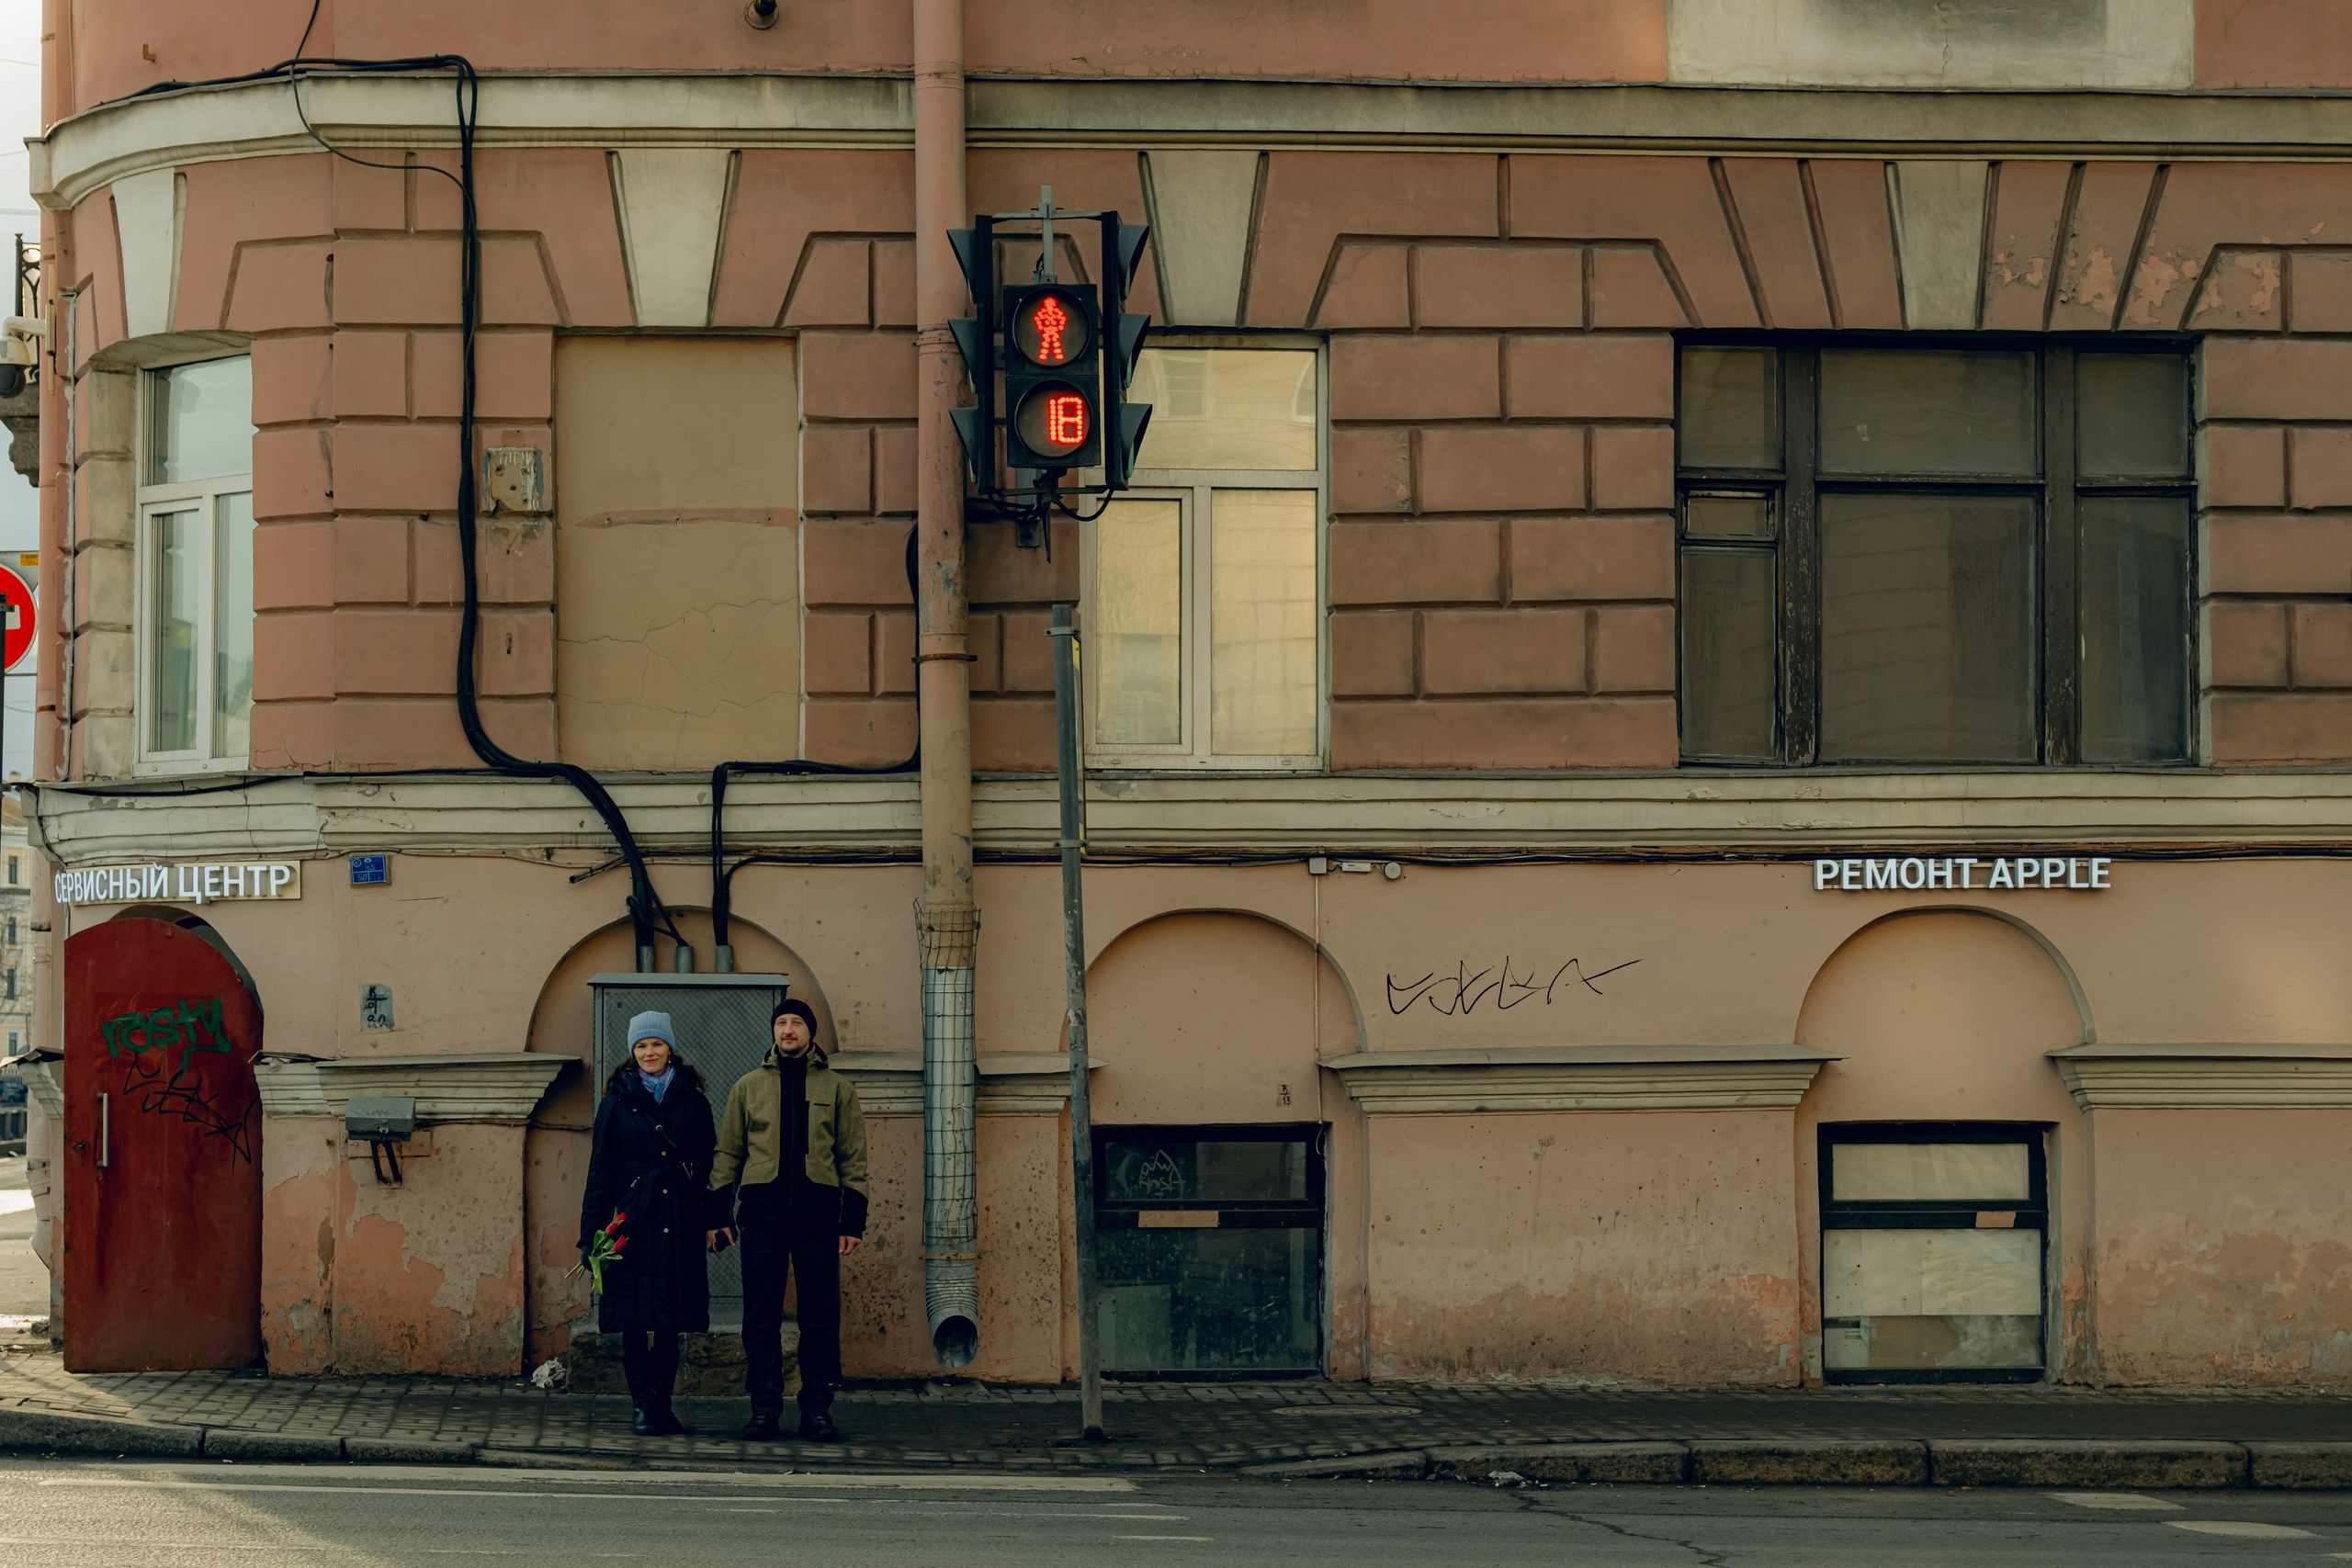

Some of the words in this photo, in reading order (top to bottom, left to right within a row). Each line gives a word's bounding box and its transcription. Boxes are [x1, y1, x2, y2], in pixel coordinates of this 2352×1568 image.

[1049, 396, 1083, 444] 18
[54, 863, 168, 904] СЕРВИСНЫЙ
[178, 864, 291, 905] ЦЕНТР
[1814, 857, 1978, 890] РЕМОНТ
[1988, 857, 2111, 889] APPLE
